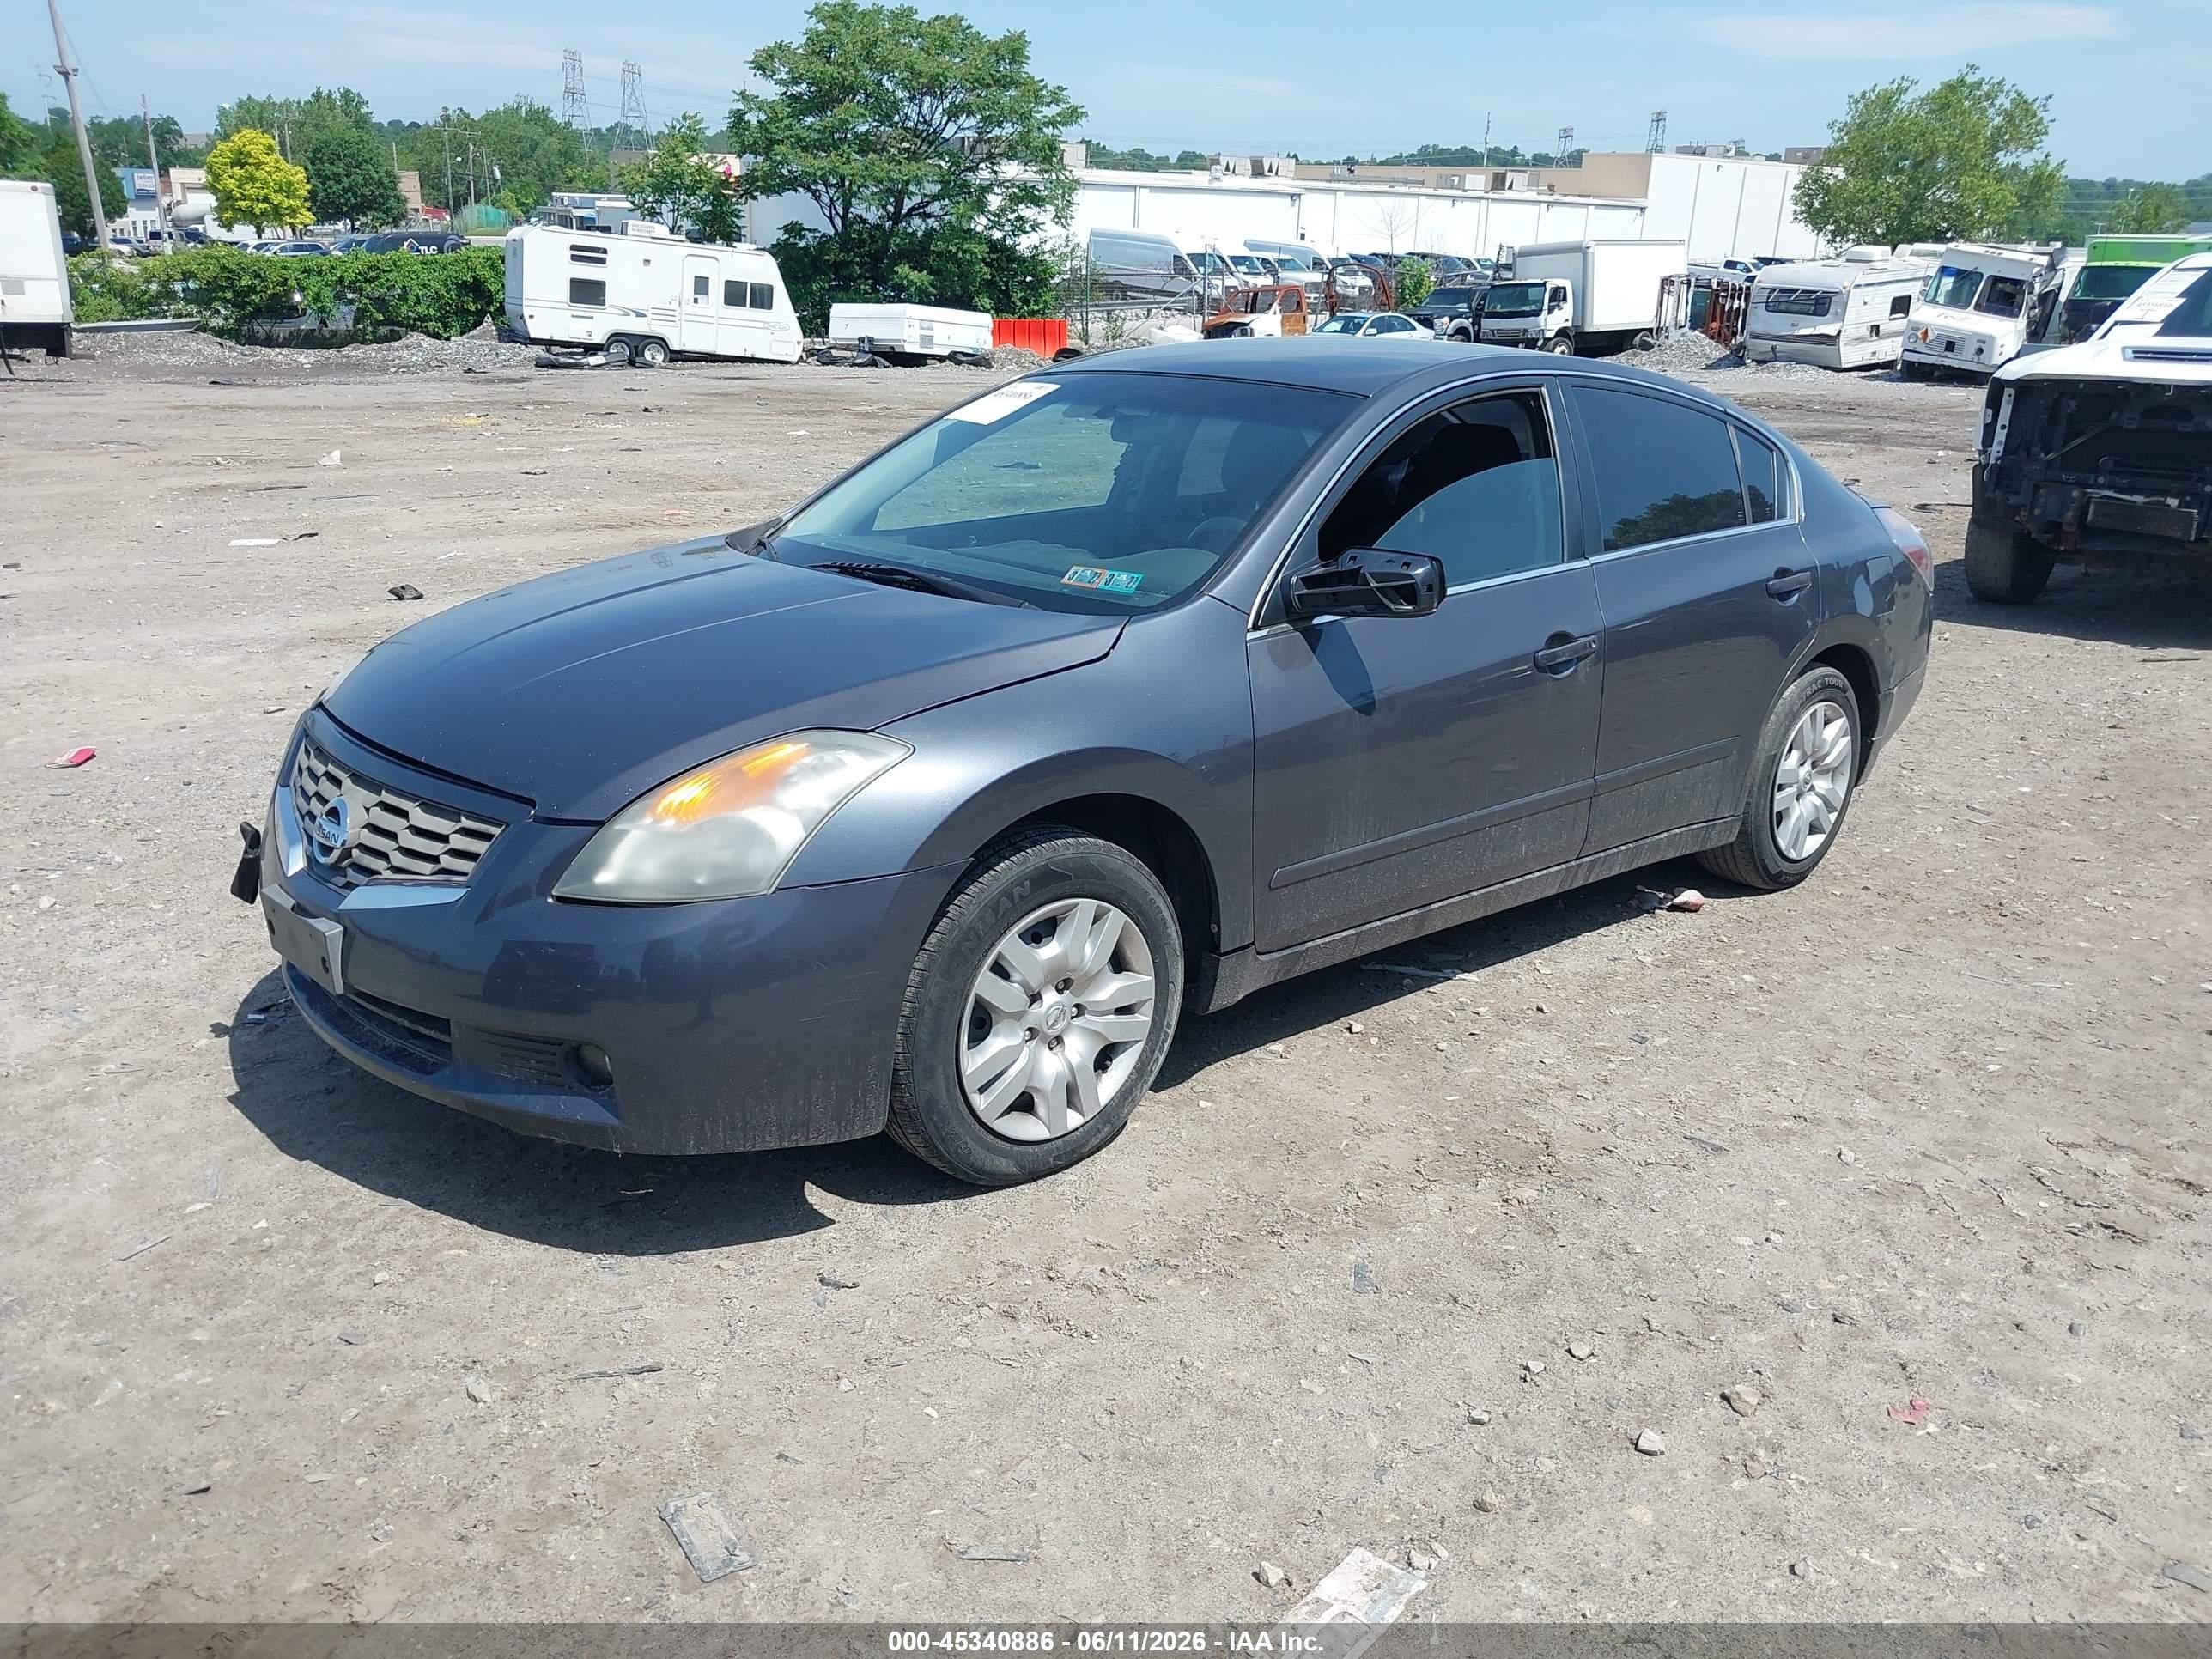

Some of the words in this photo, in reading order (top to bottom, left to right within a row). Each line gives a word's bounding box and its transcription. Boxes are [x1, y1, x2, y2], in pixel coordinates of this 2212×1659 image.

[419, 246, 438, 255] TLC
[1067, 570, 1079, 581] 3
[1104, 573, 1115, 586] 3
[1125, 575, 1139, 589] 27
